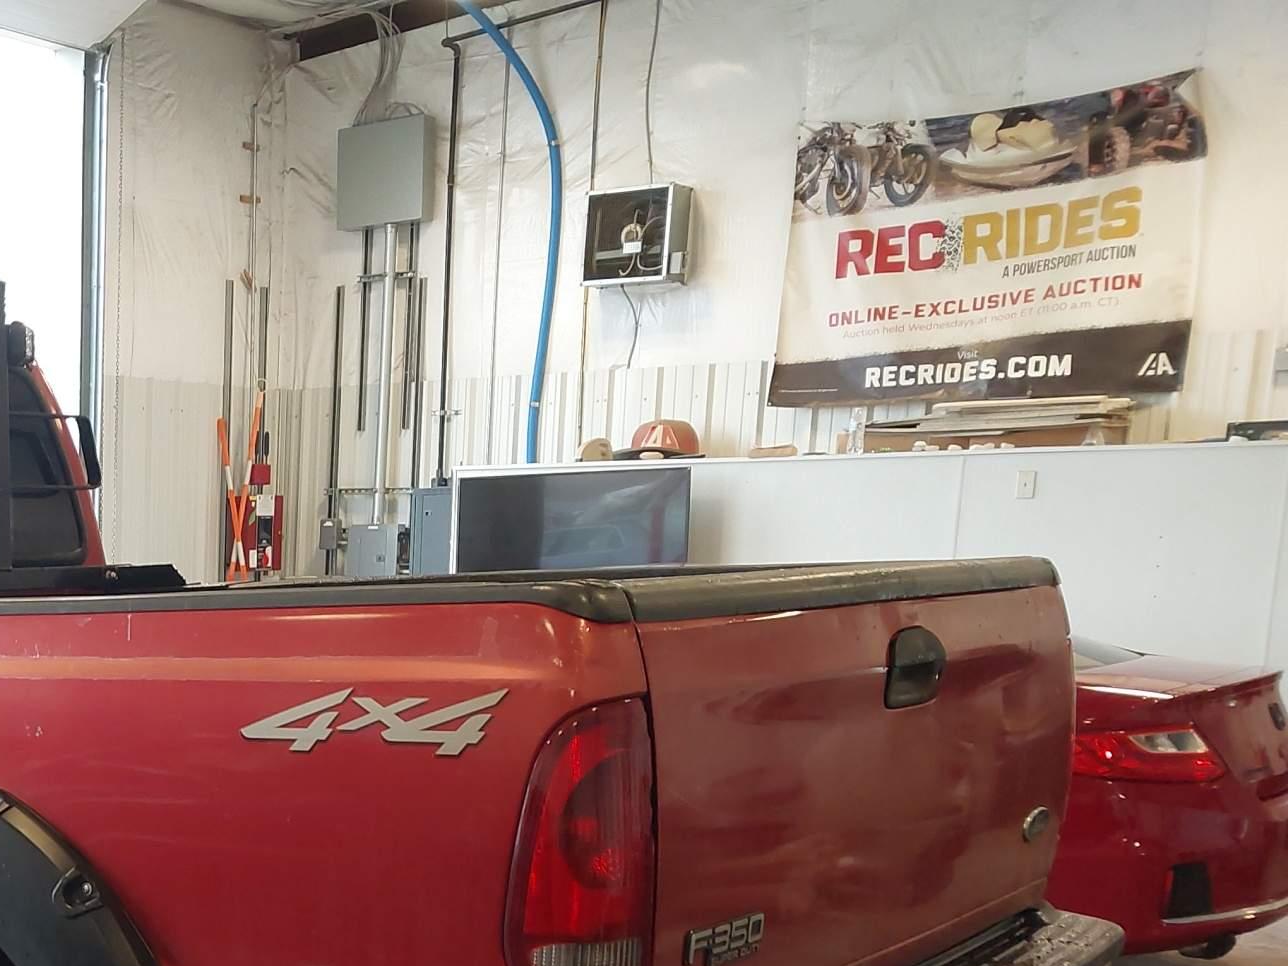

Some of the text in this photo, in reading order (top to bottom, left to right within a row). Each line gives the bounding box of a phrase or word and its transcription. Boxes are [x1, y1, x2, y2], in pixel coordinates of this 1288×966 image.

[835, 186, 1143, 279] REC RIDES
[1002, 244, 1137, 278] A POWERSPORT AUCTION
[829, 273, 1143, 327] ONLINE-EXCLUSIVE AUCTION
[842, 327, 880, 339] Auction
[882, 324, 905, 335] held
[908, 318, 974, 333] Wednesdays
[864, 354, 1073, 388] RECRIDES.COM
[957, 350, 979, 360] Visit
